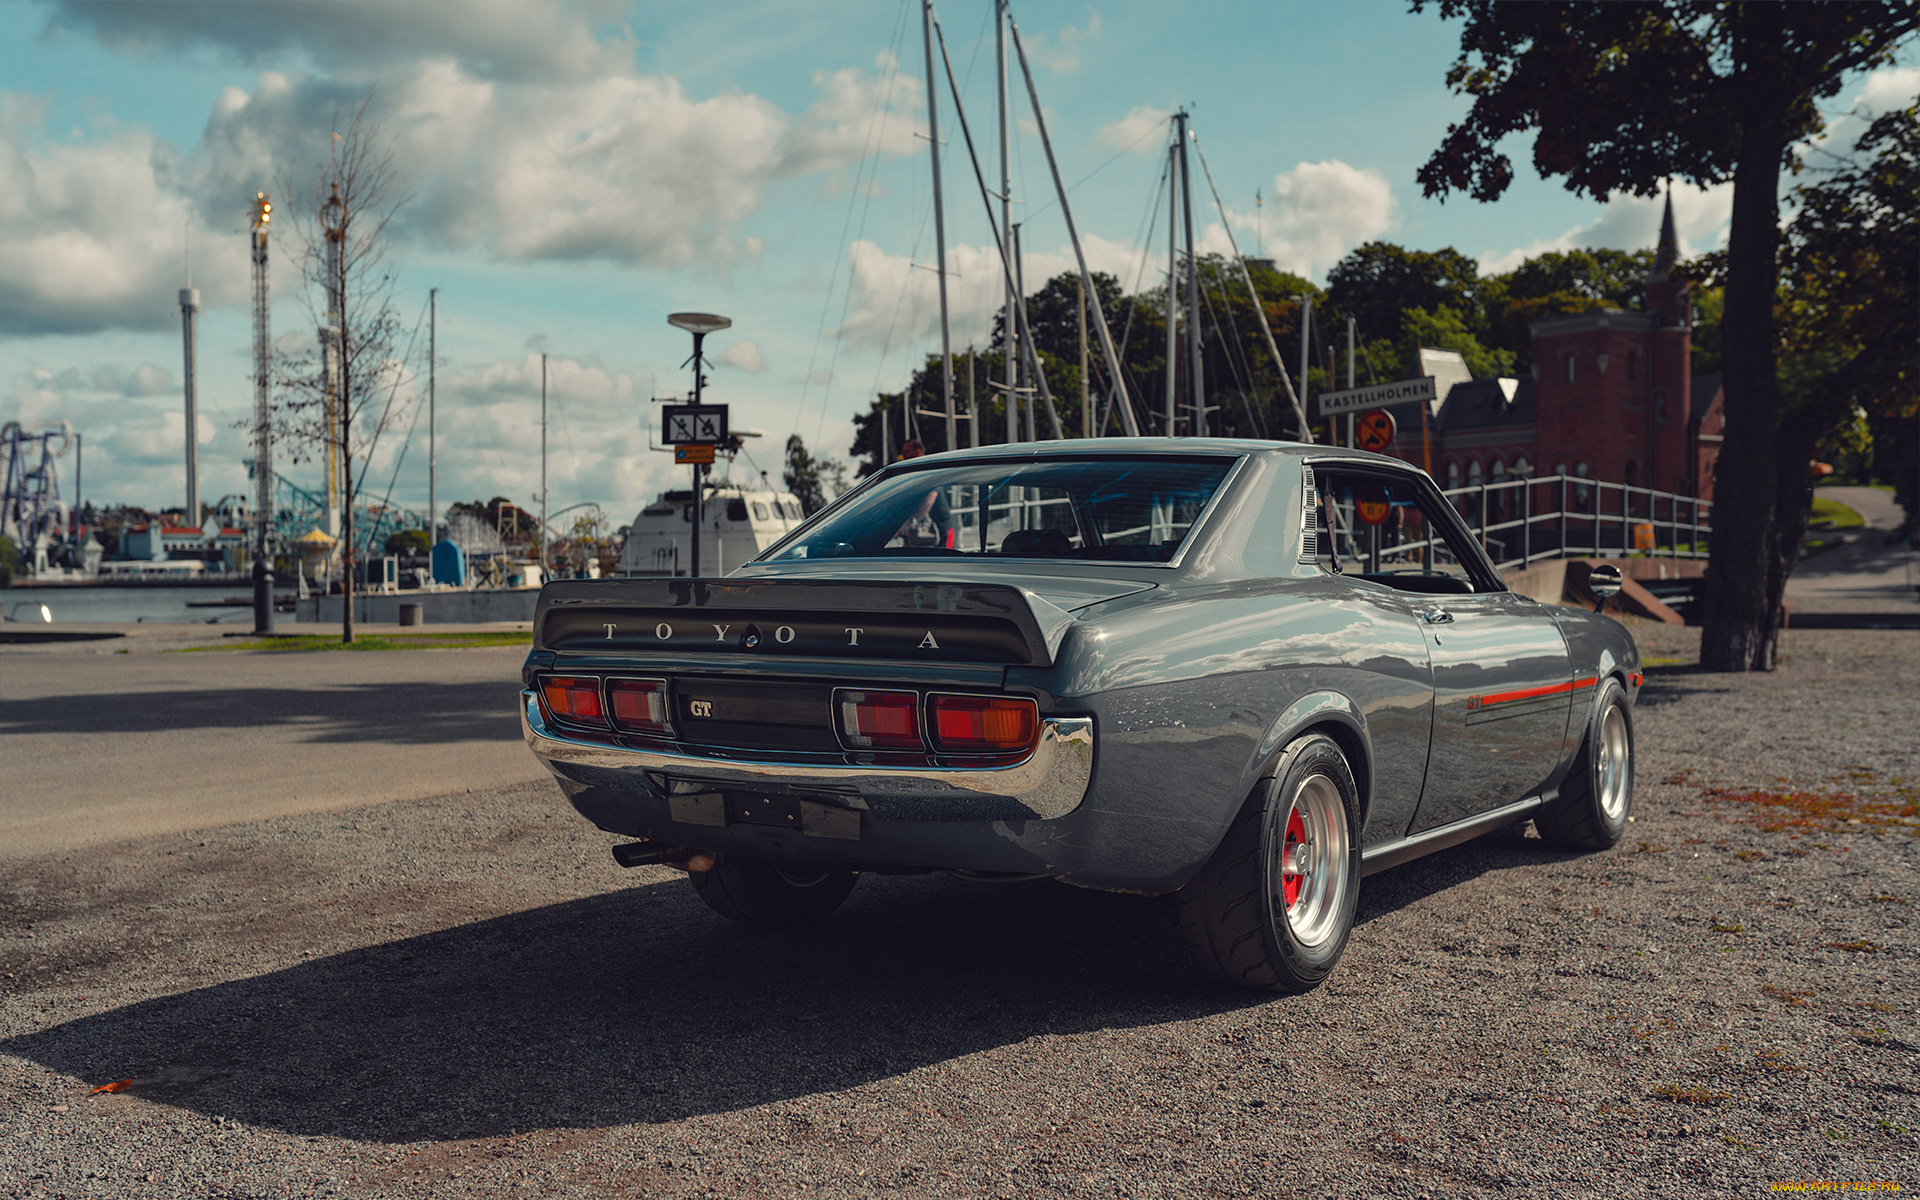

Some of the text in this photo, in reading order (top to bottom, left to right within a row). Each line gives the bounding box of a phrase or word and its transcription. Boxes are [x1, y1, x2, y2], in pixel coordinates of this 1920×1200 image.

[1325, 384, 1429, 409] KASTELLHOLMEN
[603, 623, 940, 649] TOYOTA
[690, 700, 712, 717] GT
[1467, 694, 1481, 709] GT
